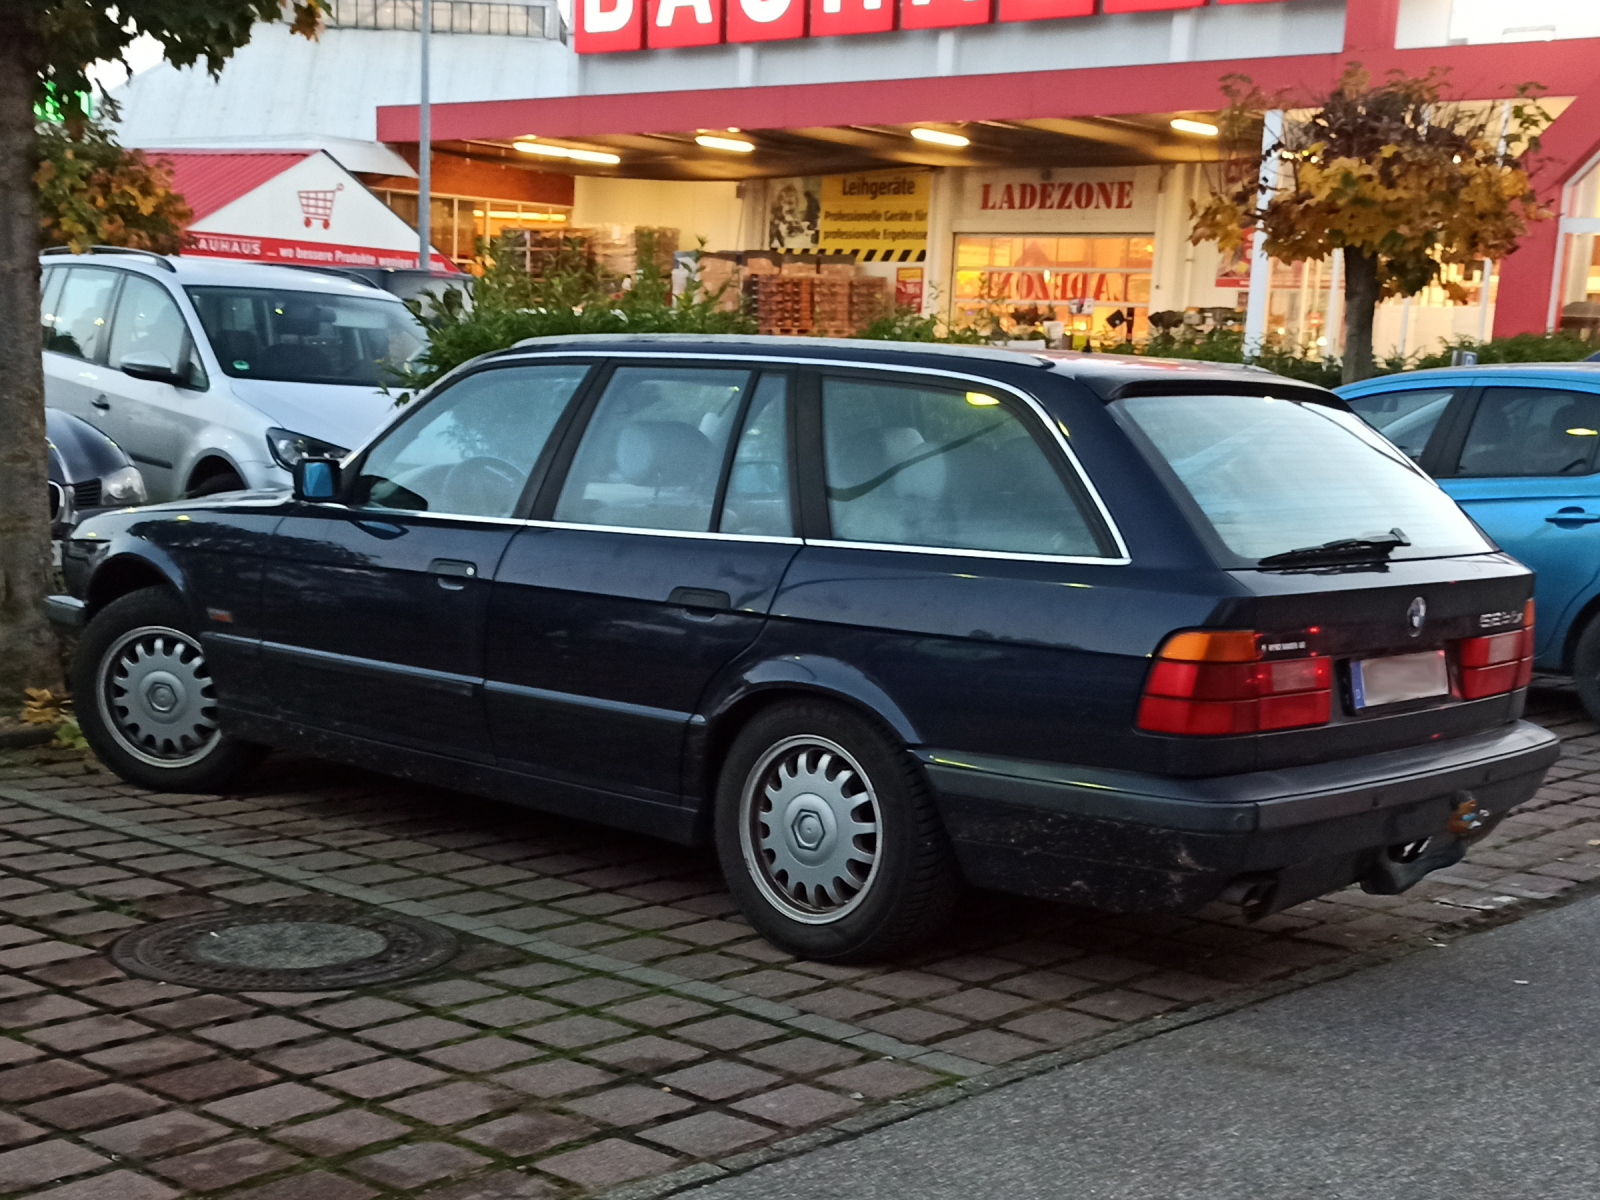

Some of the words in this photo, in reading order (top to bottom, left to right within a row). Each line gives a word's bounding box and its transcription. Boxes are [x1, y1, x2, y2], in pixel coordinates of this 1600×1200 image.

[842, 177, 916, 200] Leihgeräte
[980, 181, 1134, 210] LADEZONE
[190, 238, 262, 255] AUHAUS
